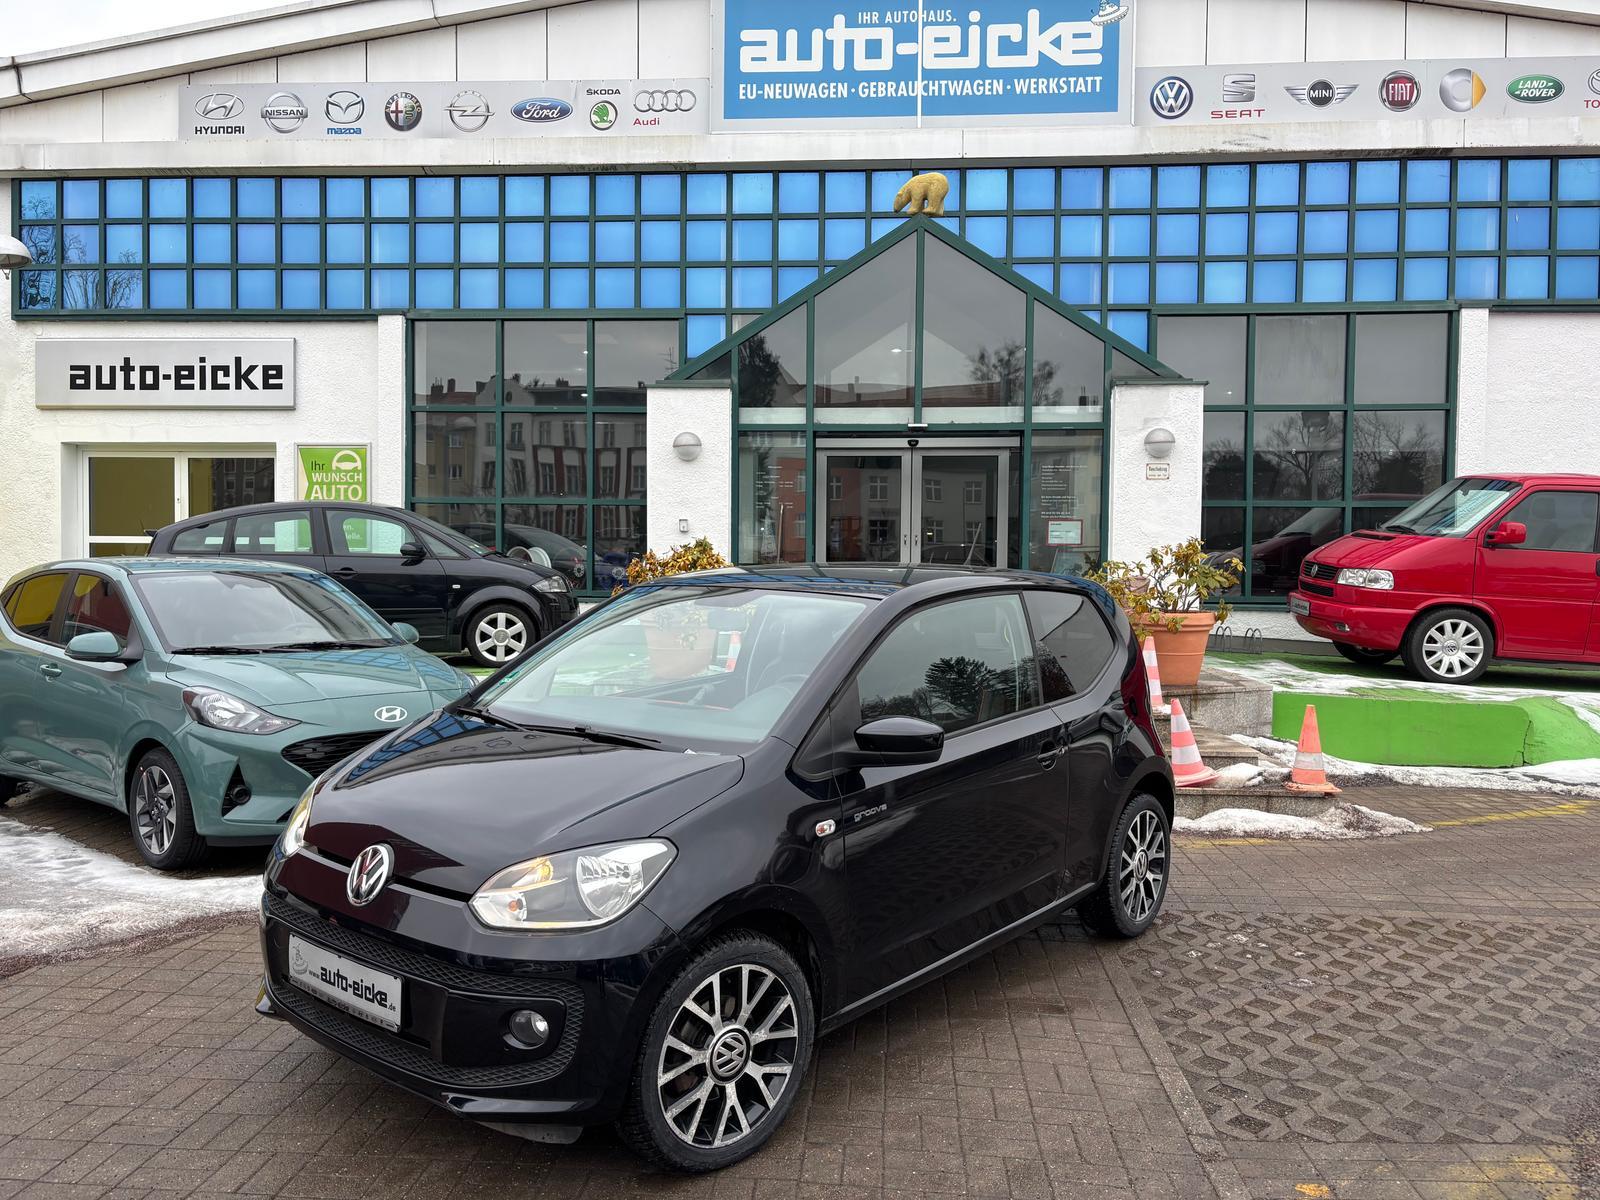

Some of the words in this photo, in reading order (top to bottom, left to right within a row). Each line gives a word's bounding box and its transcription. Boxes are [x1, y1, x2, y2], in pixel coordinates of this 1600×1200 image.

[858, 12, 879, 24] IHR
[884, 10, 957, 24] AUTOHAUS.
[739, 8, 1103, 73] auto-eicke
[586, 88, 621, 96] ŠKODA
[738, 82, 848, 99] EU-NEUWAGEN
[858, 79, 1004, 98] GEBRAUCHTWAGEN
[1013, 76, 1103, 94] WERKSTATT
[1309, 89, 1333, 98] MINI
[1388, 83, 1412, 101] FIAT
[521, 102, 562, 119] Ford
[1210, 109, 1266, 119] SEAT
[633, 118, 660, 126] Audi
[194, 126, 245, 135] HYUNDAI
[326, 127, 362, 135] mazda
[69, 356, 283, 390] auto-eicke
[311, 460, 326, 471] Ihr
[311, 472, 363, 482] WUNSCH
[310, 484, 363, 501] AUTO
[853, 803, 888, 823] groove
